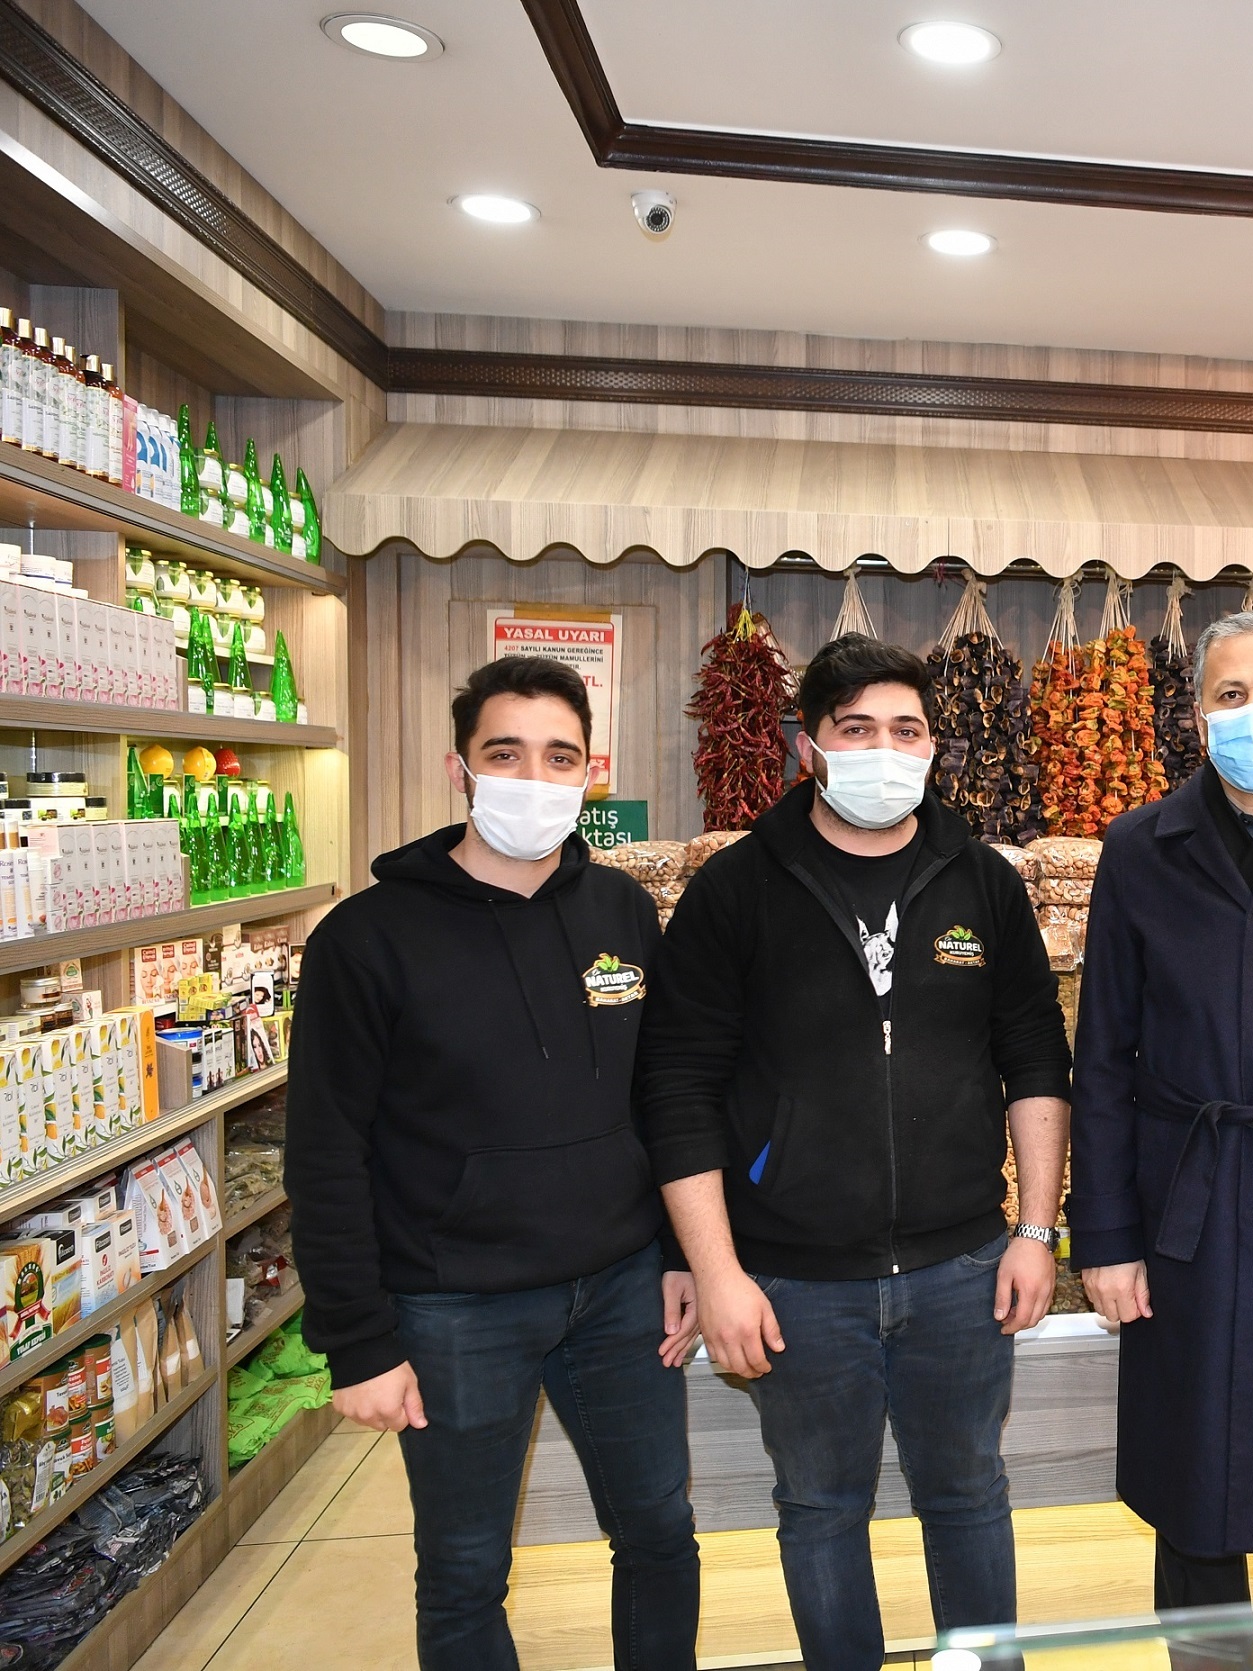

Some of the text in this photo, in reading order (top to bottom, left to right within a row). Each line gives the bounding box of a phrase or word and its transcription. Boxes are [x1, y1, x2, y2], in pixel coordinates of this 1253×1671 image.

[504, 627, 605, 642] YASAL UYARI
[567, 647, 604, 655] GEREĞİNCE
[559, 655, 604, 663] MAMULLERİNİ
[579, 807, 619, 829] atış
[582, 827, 632, 847] ktası
[938, 940, 983, 952] NATUREL
[585, 970, 640, 988] NATUREL
